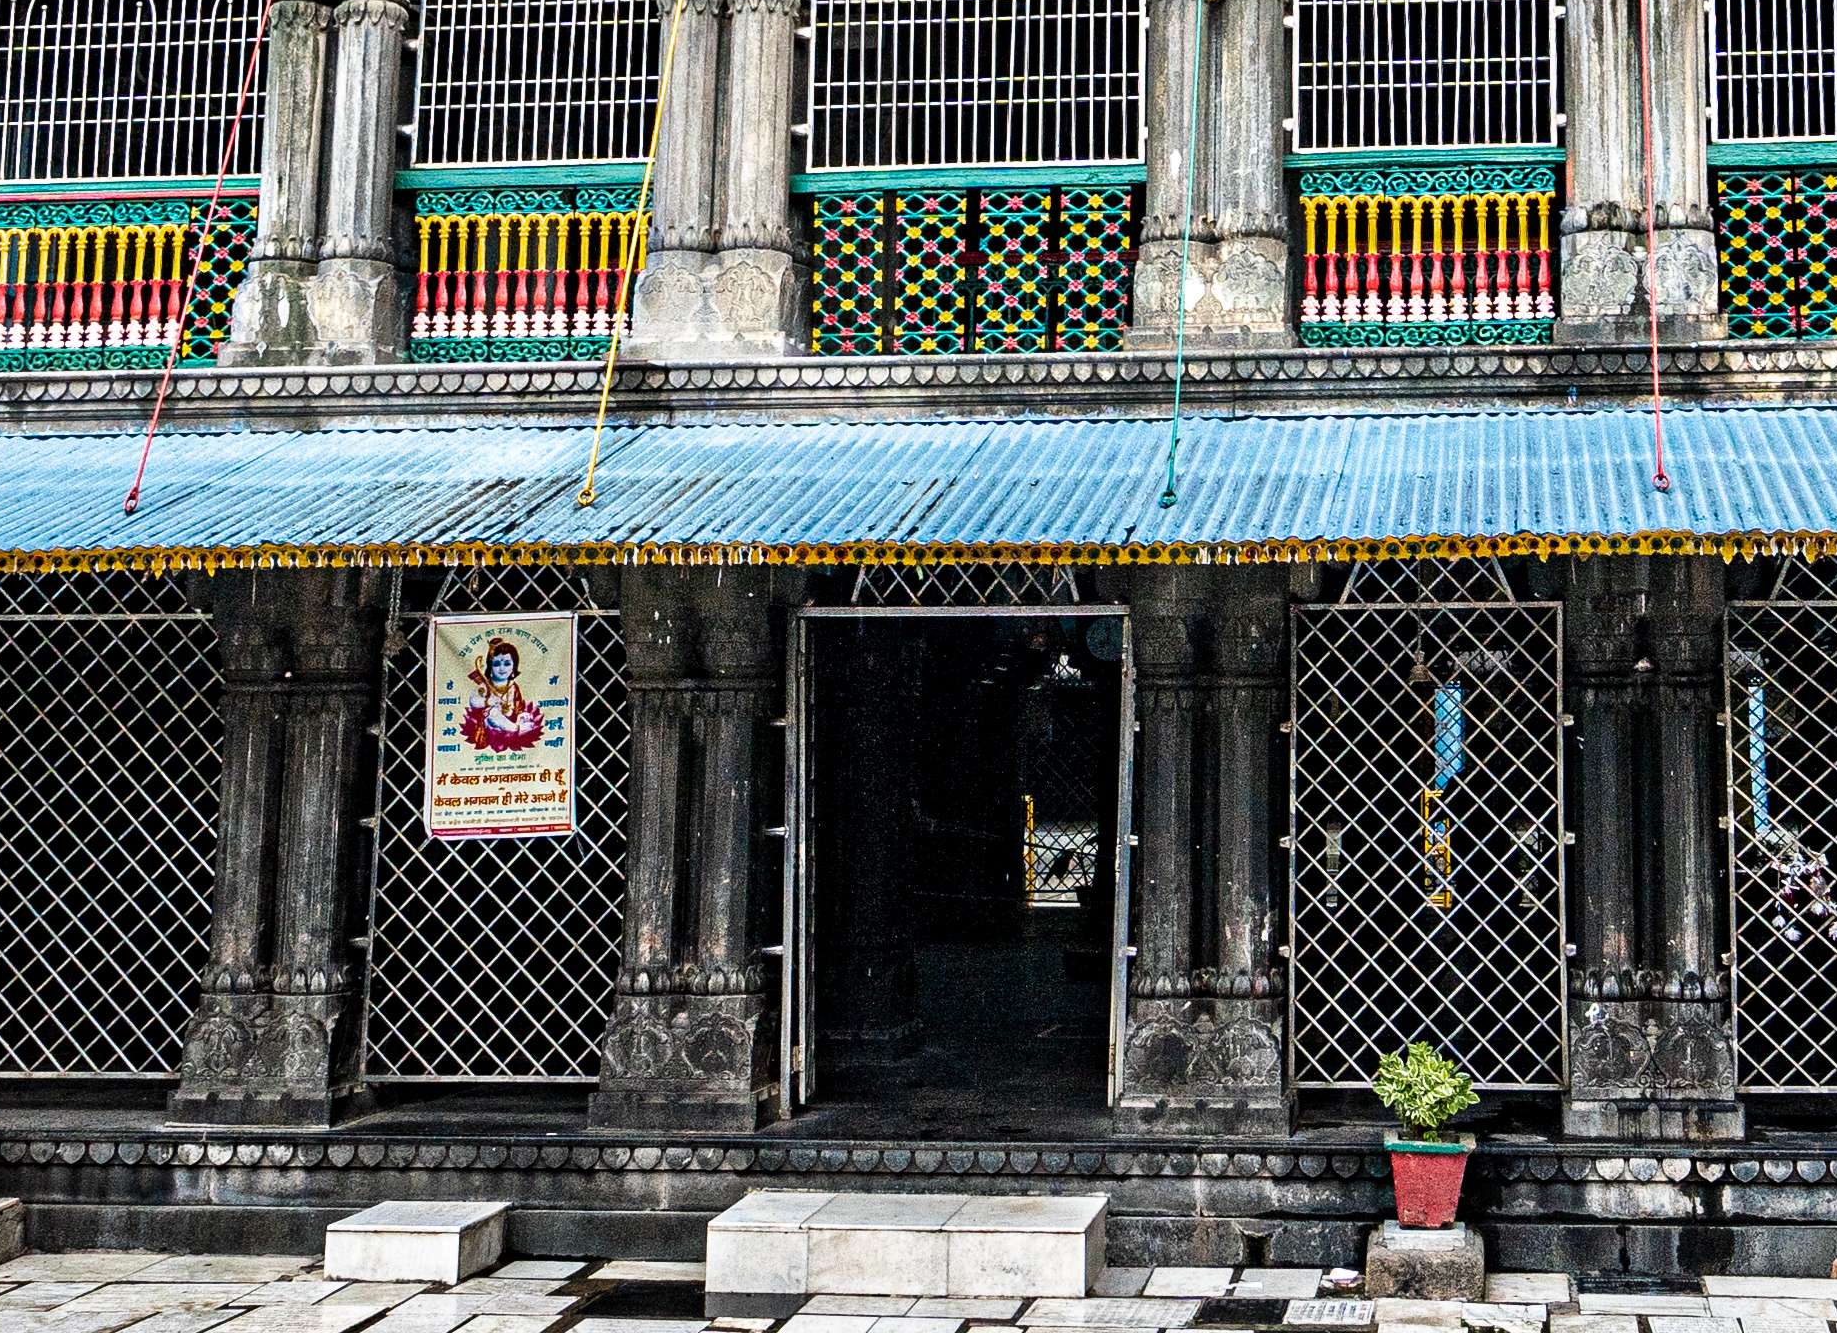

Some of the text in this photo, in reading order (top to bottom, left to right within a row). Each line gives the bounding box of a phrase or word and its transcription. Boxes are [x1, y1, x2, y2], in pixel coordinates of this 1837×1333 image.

[537, 697, 569, 707] आपको
[436, 773, 448, 786] मैं
[450, 773, 480, 785] केवल
[482, 772, 536, 784] भगवानका
[538, 769, 551, 782] ही
[434, 794, 461, 807] केवल
[463, 795, 499, 806] भगवान
[502, 792, 512, 806] ही
[514, 791, 529, 804] मेरे
[531, 790, 556, 803] अपने
